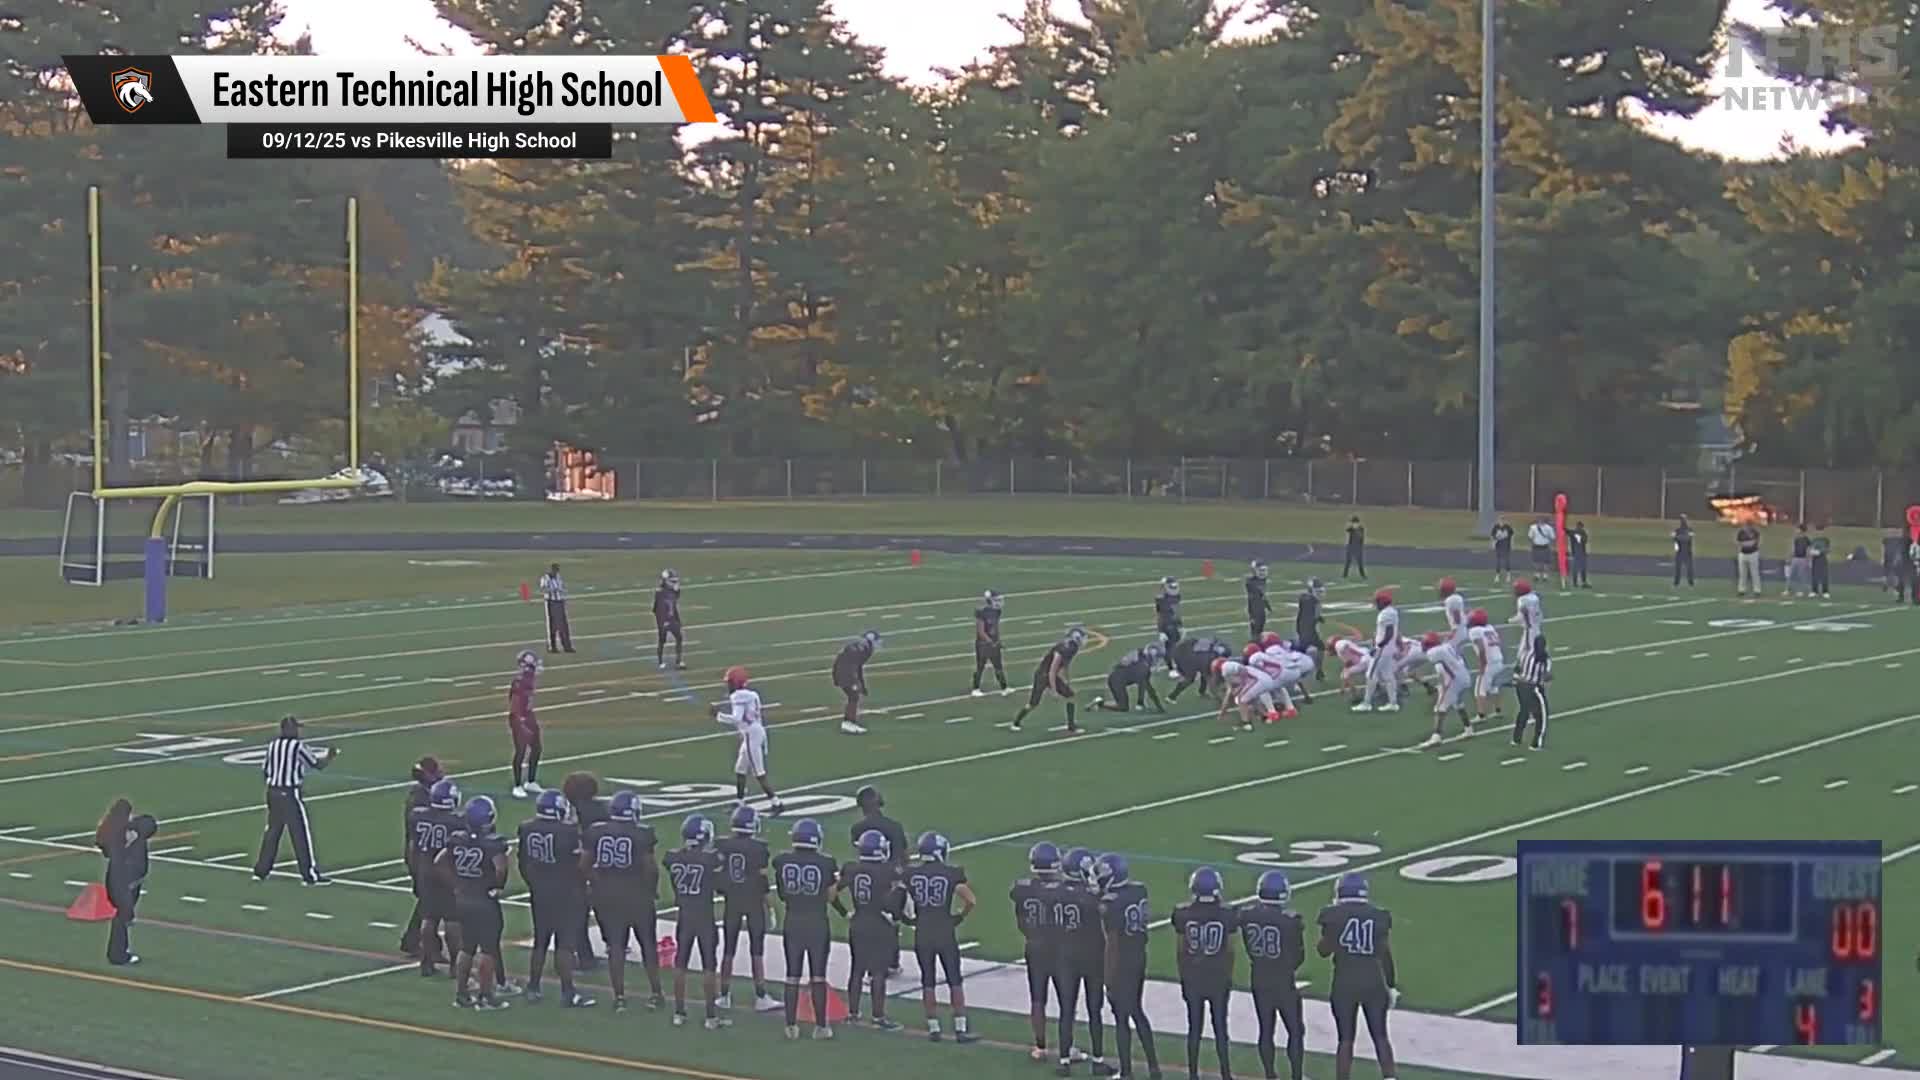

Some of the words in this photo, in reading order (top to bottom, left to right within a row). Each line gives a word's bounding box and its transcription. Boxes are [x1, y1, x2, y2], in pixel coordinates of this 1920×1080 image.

[453, 846, 485, 877] 22
[527, 832, 556, 864] 61
[598, 835, 633, 868] 69
[670, 863, 705, 895] 27
[782, 863, 822, 895] 89
[854, 873, 872, 905] 6
[910, 874, 949, 906] 33
[1248, 922, 1281, 959] 28
[1339, 918, 1375, 955] 41
[1577, 964, 1627, 994] PLACE
[1639, 964, 1691, 994] EVENT
[1718, 965, 1761, 995] HEAT
[1785, 967, 1829, 996] LANE
[1859, 978, 1875, 1021] 3
